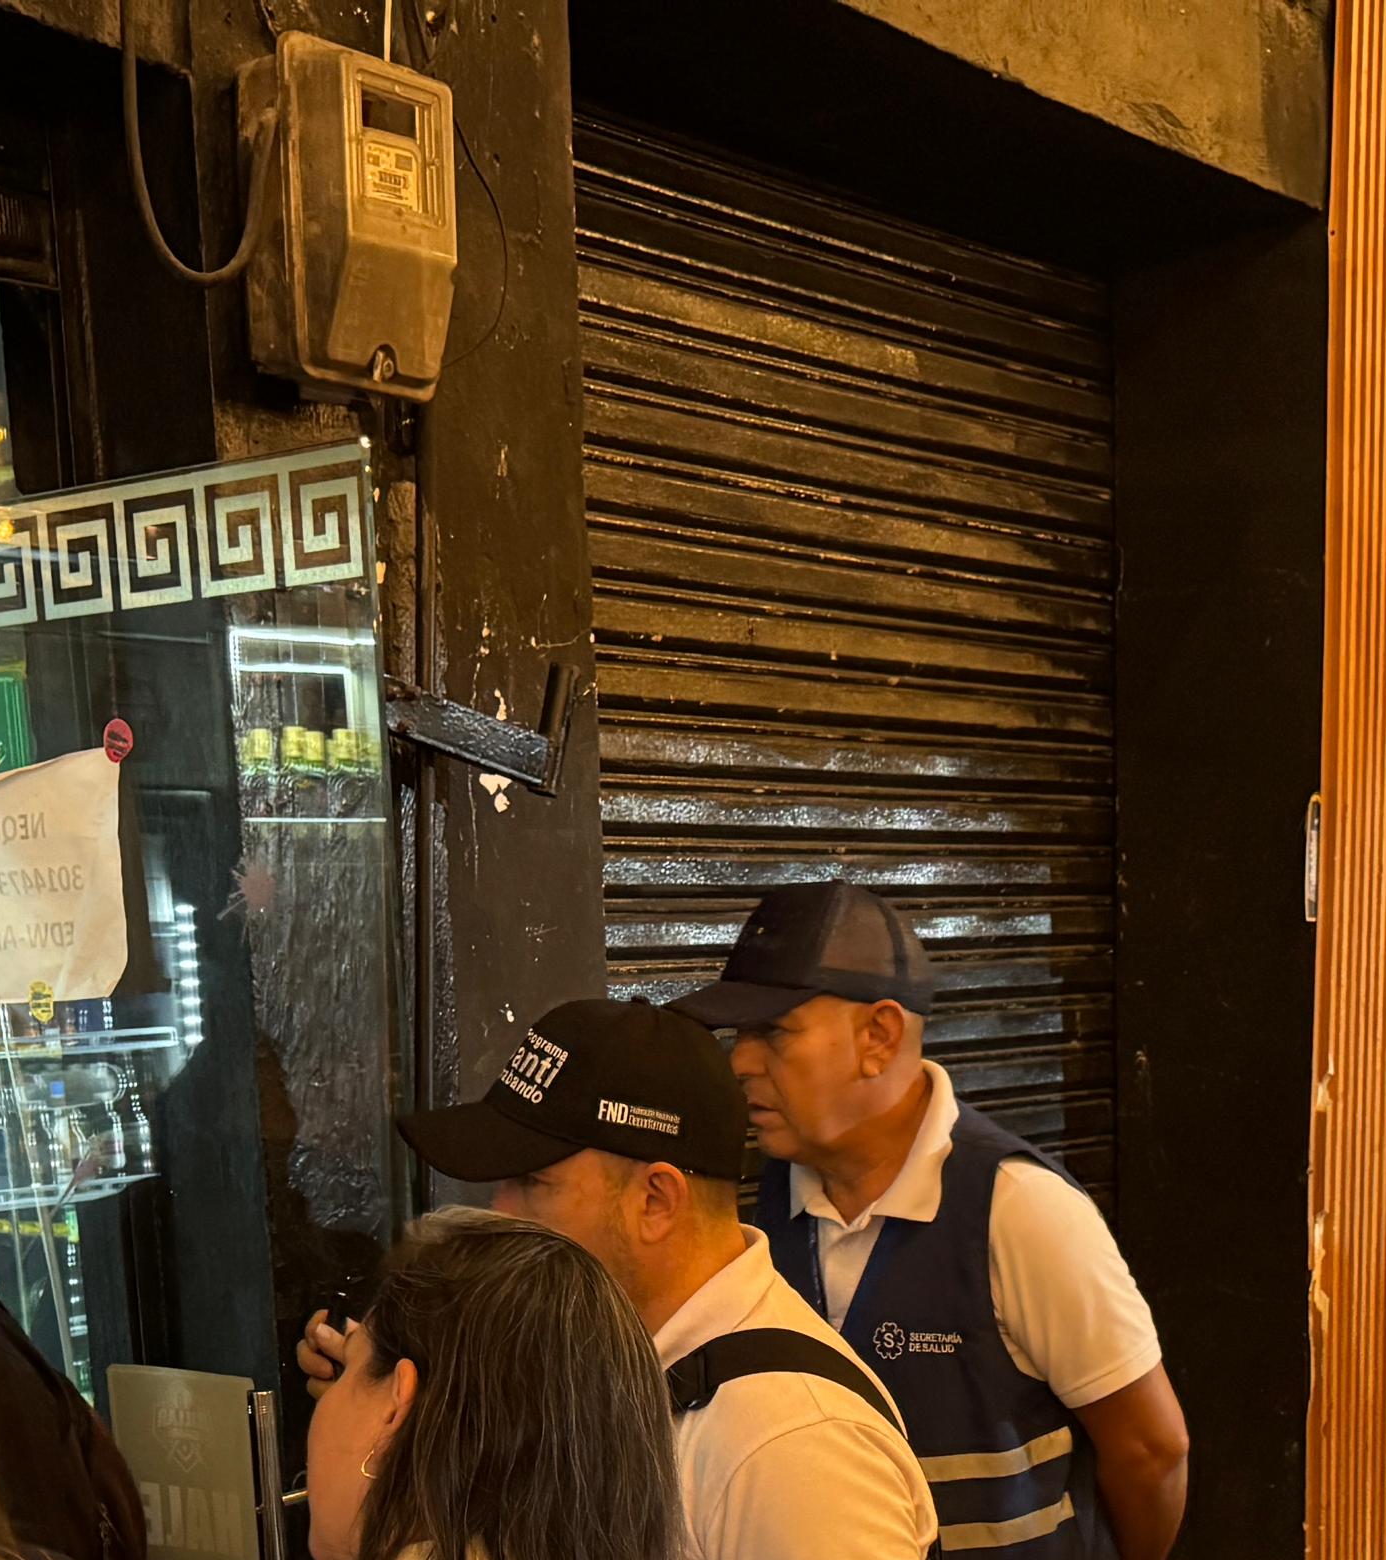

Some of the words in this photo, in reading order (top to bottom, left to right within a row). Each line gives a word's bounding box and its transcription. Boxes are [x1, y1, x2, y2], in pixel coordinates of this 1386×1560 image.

[597, 1098, 630, 1125] FND
[883, 1332, 895, 1348] S
[909, 1332, 963, 1344] SECRETARÍA
[922, 1343, 955, 1354] SALUD
